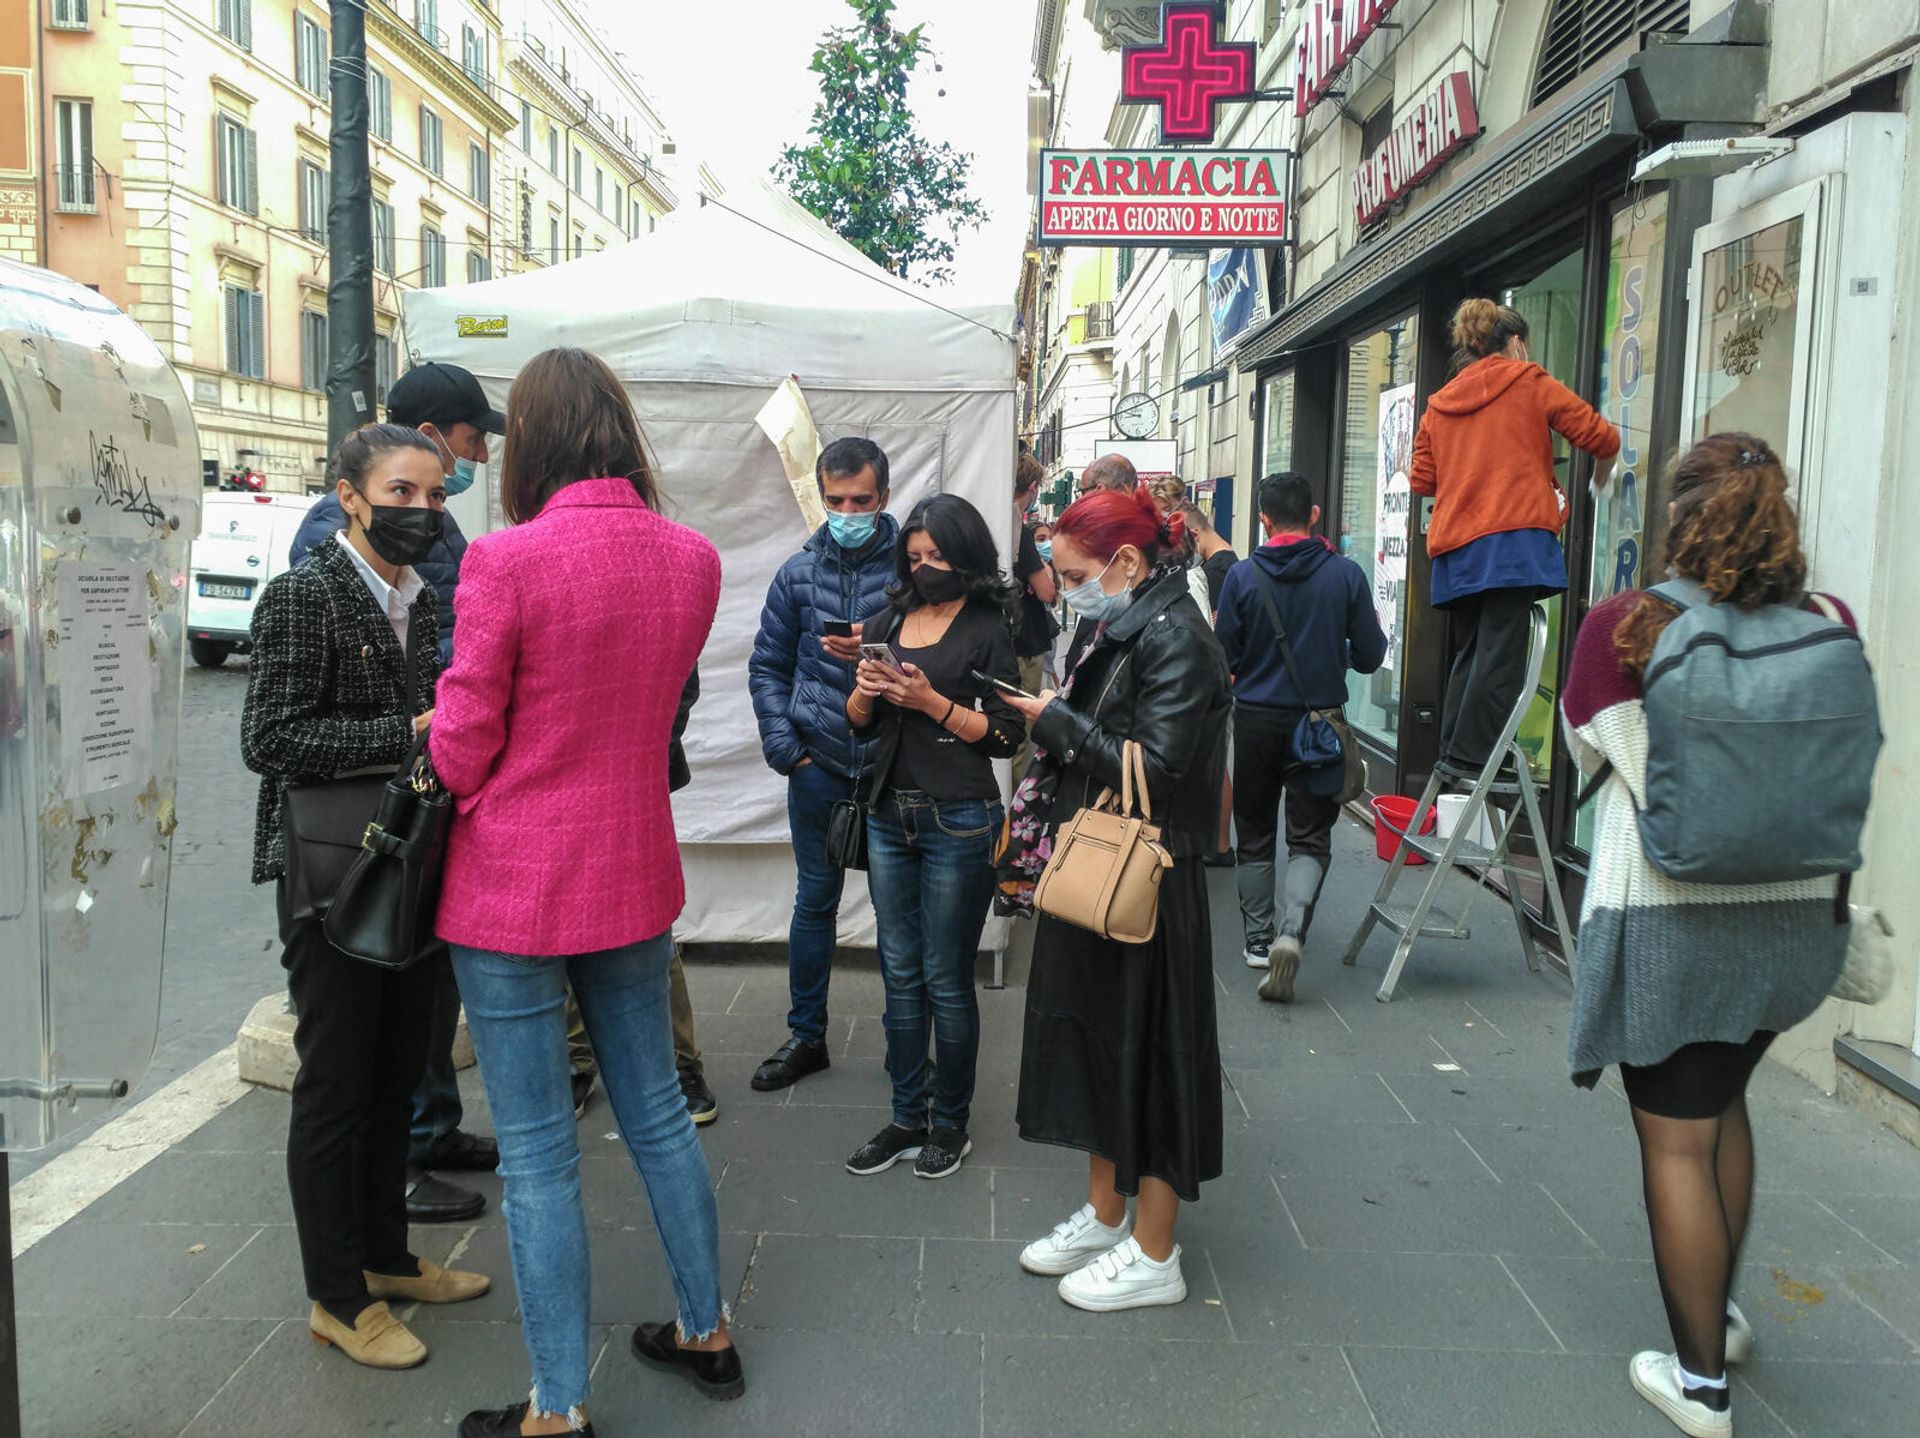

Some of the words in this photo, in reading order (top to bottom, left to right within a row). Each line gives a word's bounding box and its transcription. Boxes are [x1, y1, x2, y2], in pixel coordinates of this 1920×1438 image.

[1350, 73, 1463, 222] PROFUMERIA
[1048, 155, 1281, 197] FARMACIA
[1048, 206, 1119, 231] APERTA
[1124, 206, 1195, 232] GIORNO
[1200, 207, 1213, 232] E
[1217, 207, 1280, 233] NOTTE
[1715, 261, 1784, 313] OUTLET
[1612, 265, 1644, 595] SOLAR
